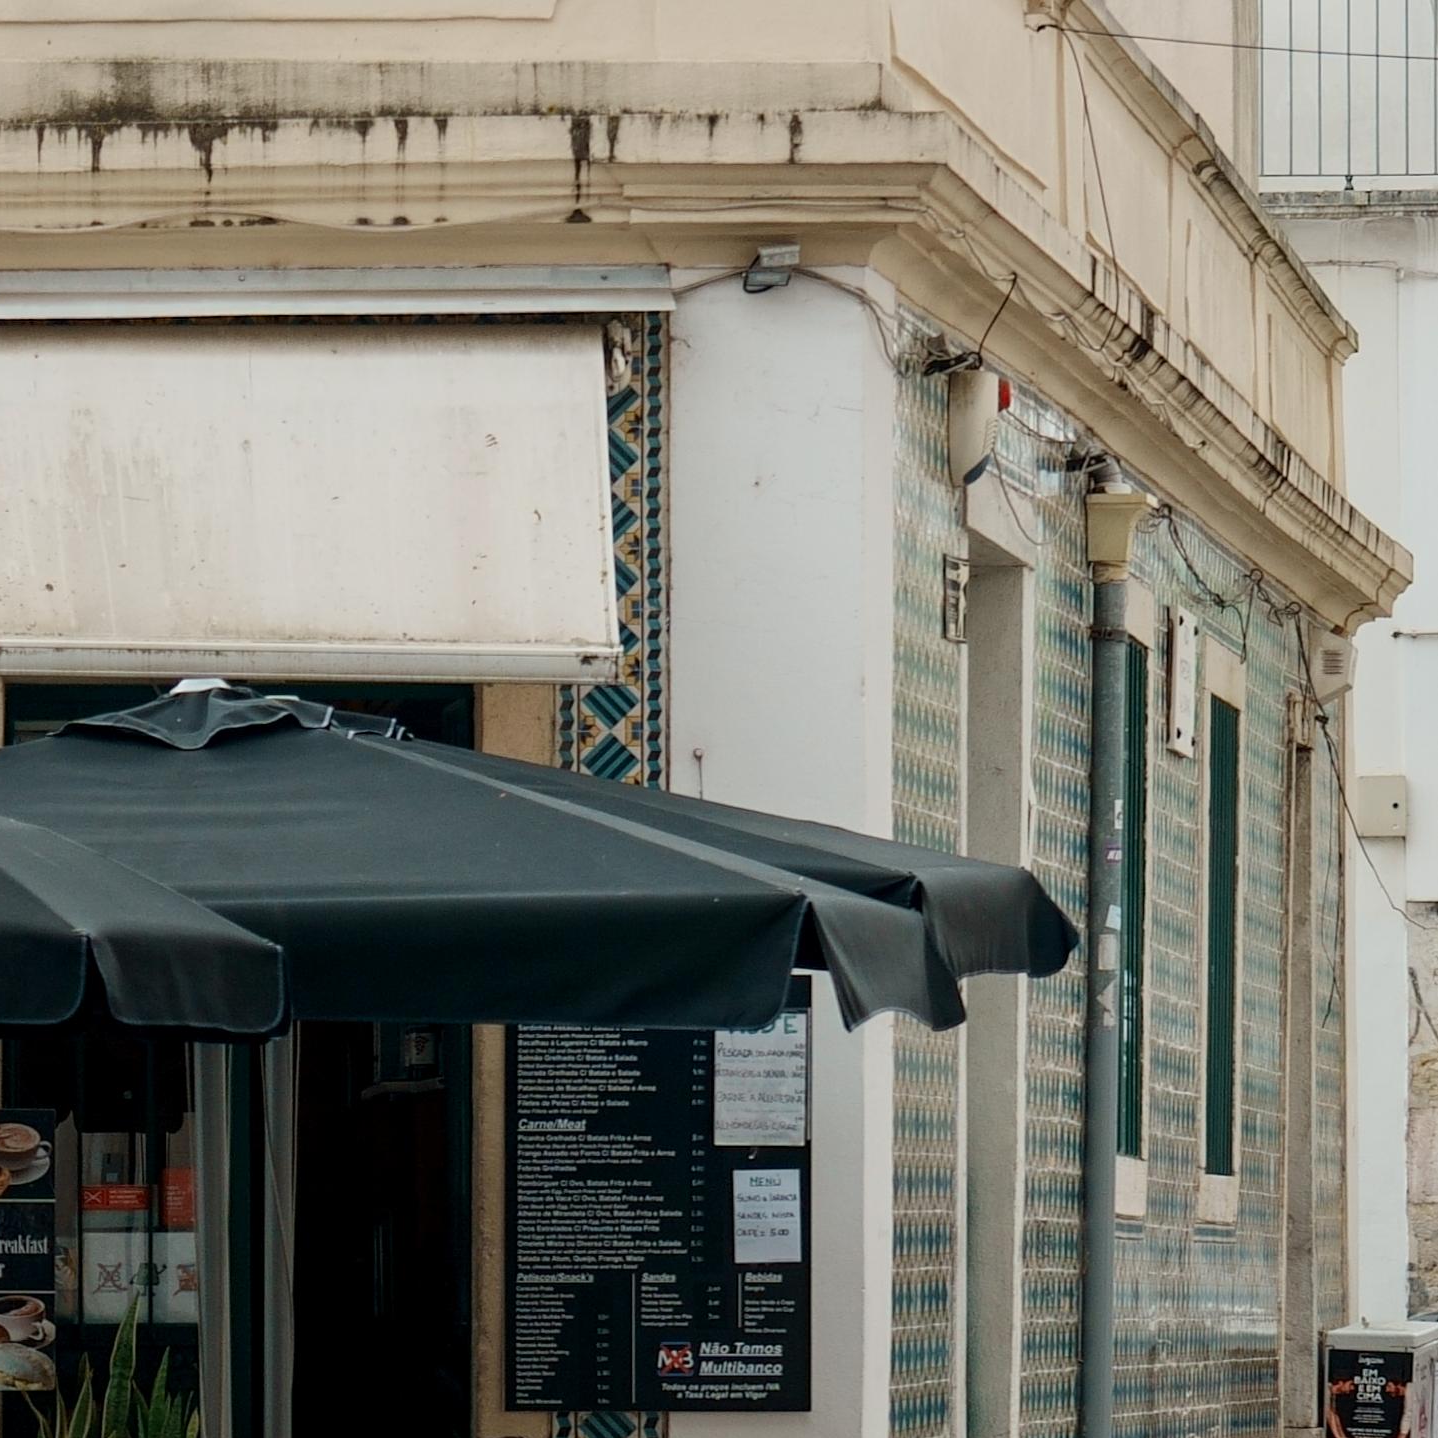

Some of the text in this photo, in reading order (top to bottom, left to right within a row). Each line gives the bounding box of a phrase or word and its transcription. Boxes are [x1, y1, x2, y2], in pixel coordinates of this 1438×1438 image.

[518, 1118, 586, 1130] Carne/Meat
[516, 1272, 594, 1283] Petiscos/Snack's
[642, 1272, 676, 1282] Sandes
[745, 1272, 783, 1282] Bebidas
[699, 1342, 784, 1355] Não Temos
[699, 1360, 784, 1372] Multibanco
[1362, 1369, 1379, 1378] EM
[1354, 1376, 1387, 1386] BAIXO
[1366, 1385, 1382, 1393] EM
[1356, 1392, 1383, 1401] CIMA
